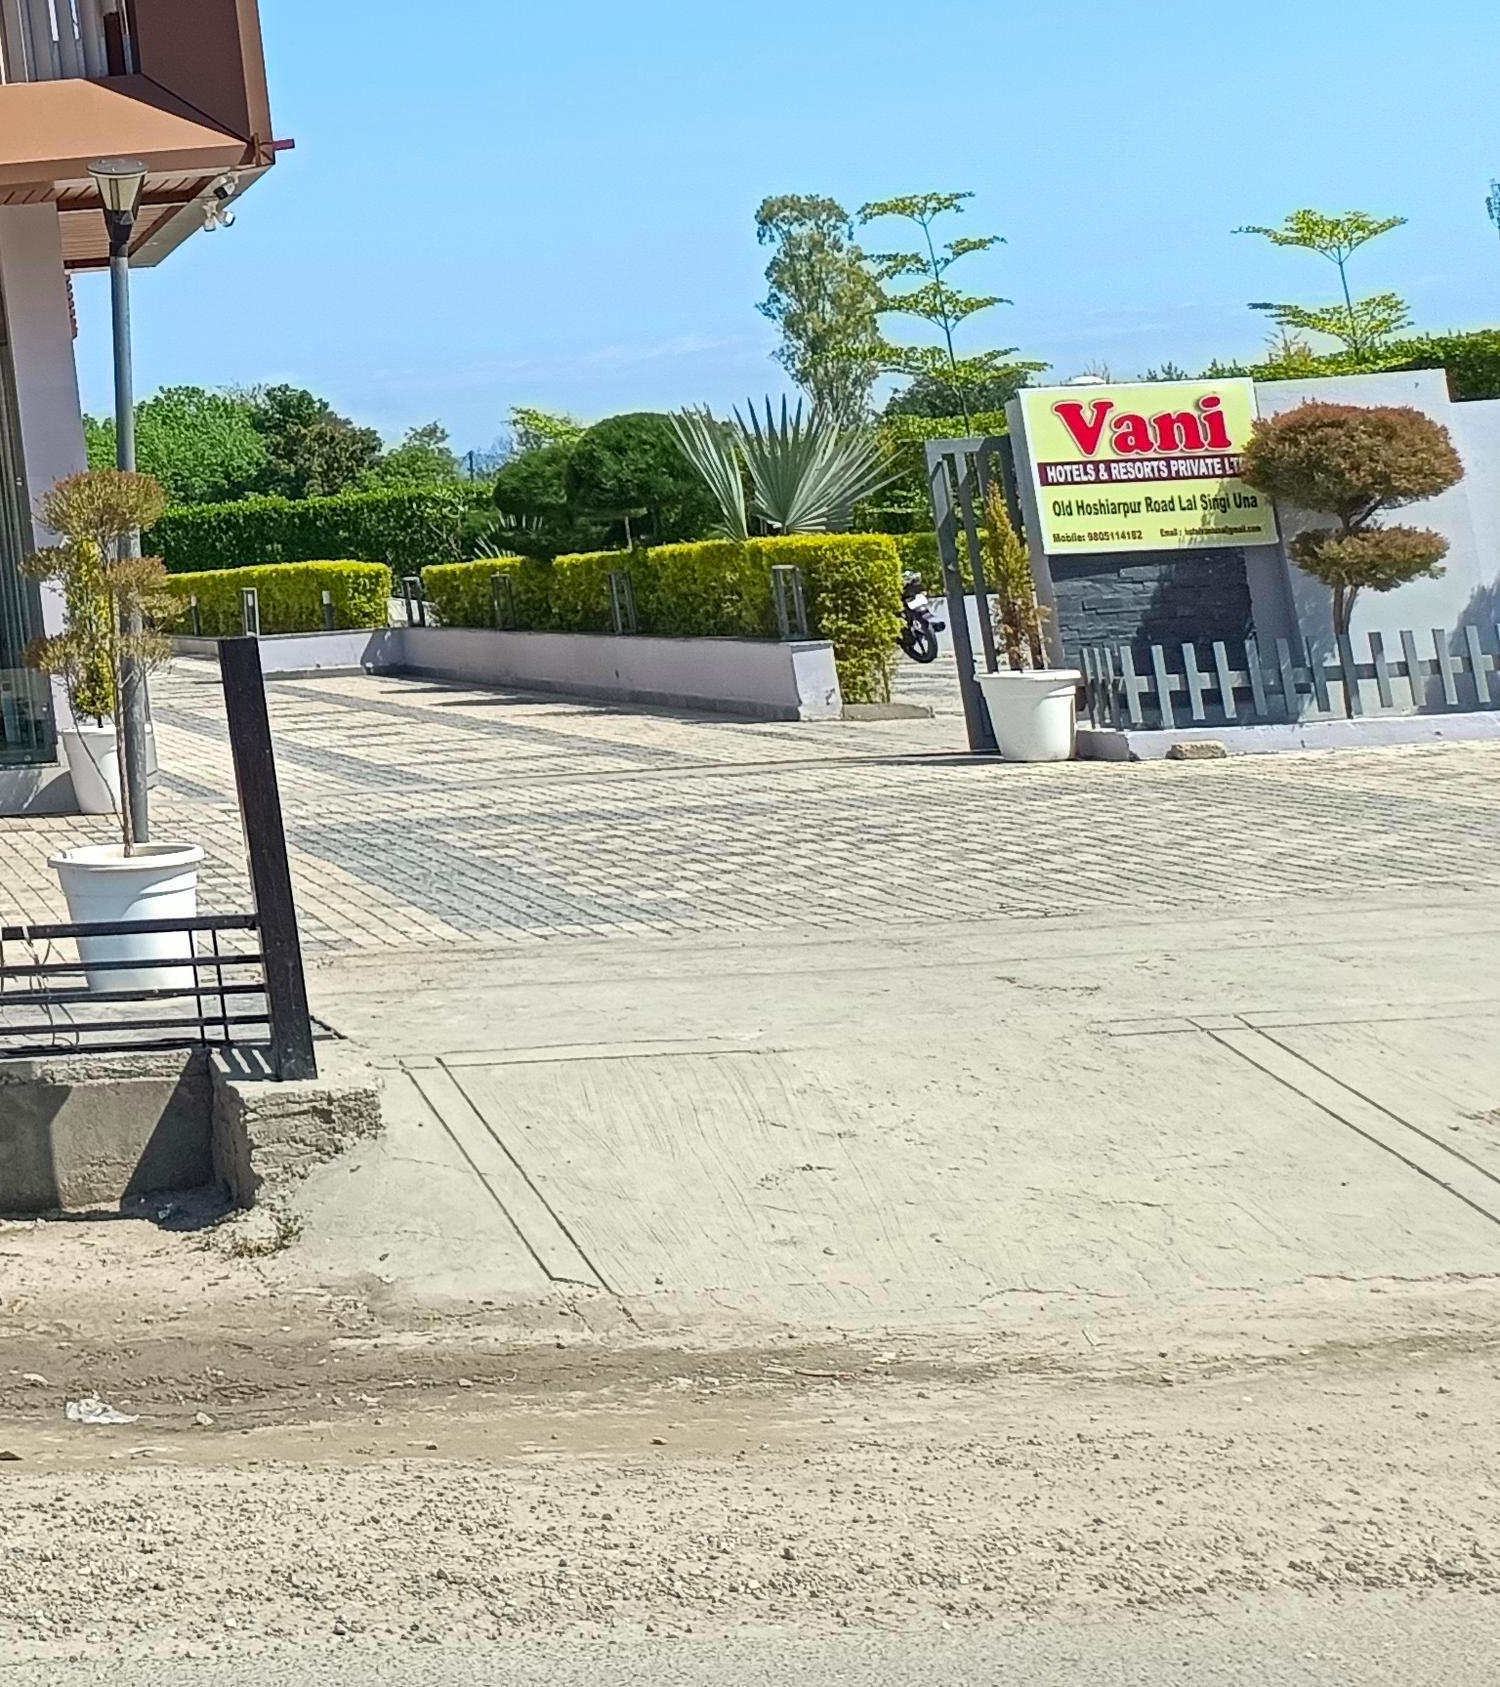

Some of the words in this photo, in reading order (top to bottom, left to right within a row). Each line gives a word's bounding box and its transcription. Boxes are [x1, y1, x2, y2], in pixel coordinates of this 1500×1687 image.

[1053, 394, 1233, 457] Vani
[1046, 463, 1096, 483] HOTELS
[1098, 462, 1109, 481] &
[1110, 459, 1169, 480] RESORTS
[1169, 456, 1223, 478] PRIVATE
[1223, 456, 1245, 475] LT
[1052, 499, 1073, 517] Old
[1075, 497, 1142, 519] Hoshiarpur
[1144, 494, 1176, 513] Road
[1178, 493, 1198, 512] Lal
[1200, 492, 1230, 514] Singi
[1232, 492, 1258, 509] Una
